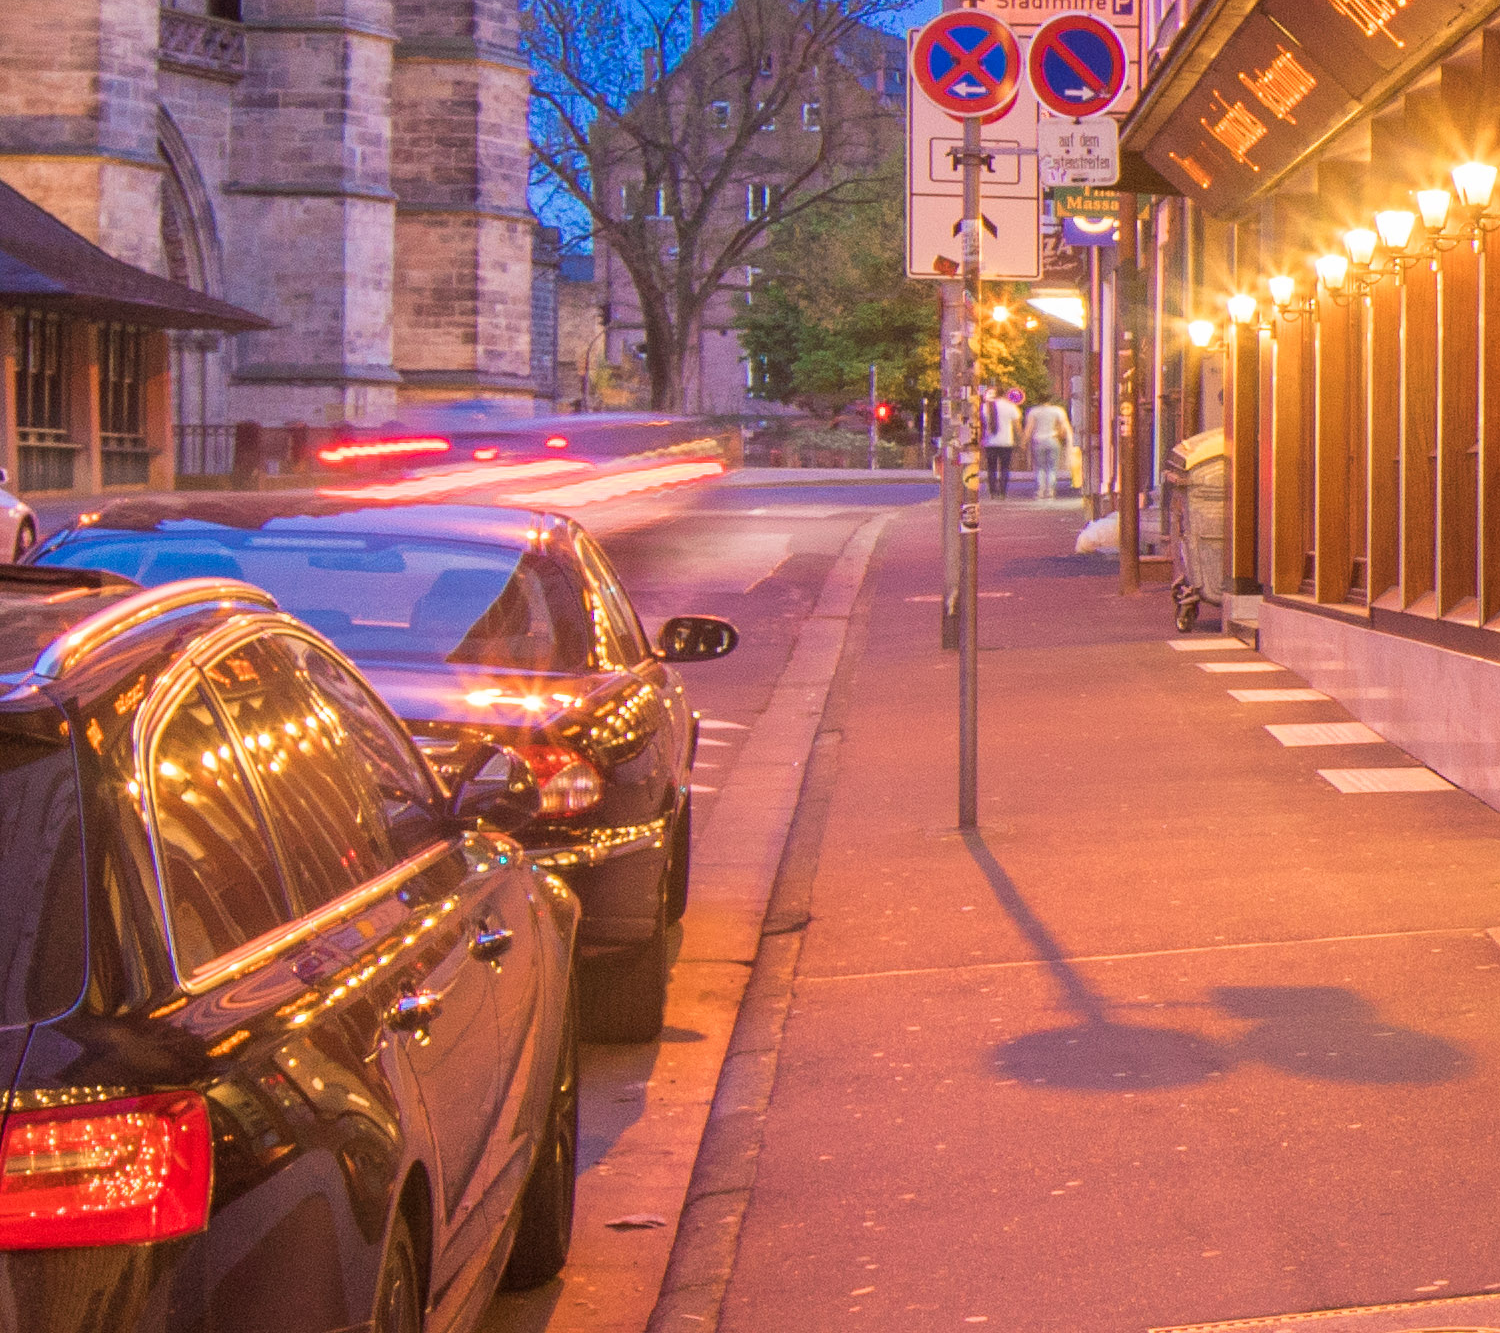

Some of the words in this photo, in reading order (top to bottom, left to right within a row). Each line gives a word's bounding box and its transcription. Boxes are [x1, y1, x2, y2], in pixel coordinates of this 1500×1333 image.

[1058, 132, 1074, 148] auf
[1080, 132, 1100, 148] dem
[1066, 195, 1120, 211] Massa
